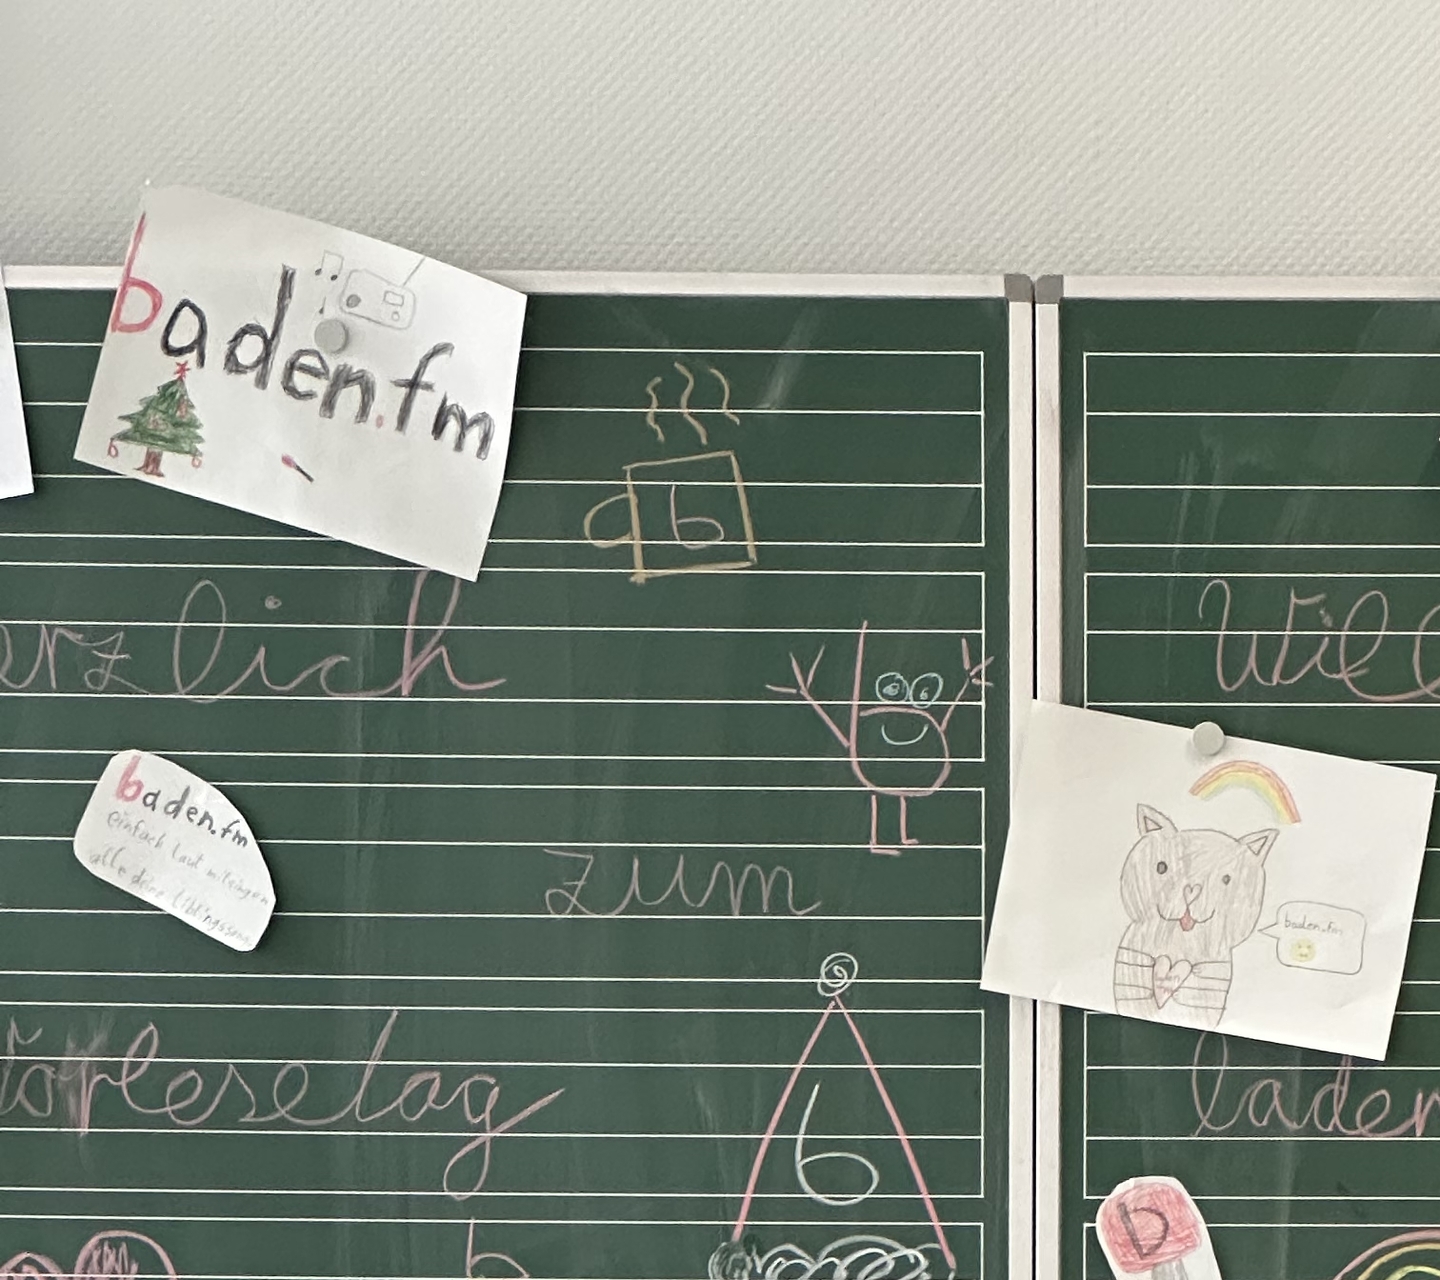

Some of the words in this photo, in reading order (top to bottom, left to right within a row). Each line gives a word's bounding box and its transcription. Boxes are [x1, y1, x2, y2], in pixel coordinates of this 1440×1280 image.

[111, 211, 495, 460] baden.fm
[116, 756, 248, 847] baden.fm
[543, 848, 821, 917] zum
[1284, 910, 1343, 935] baden.fm
